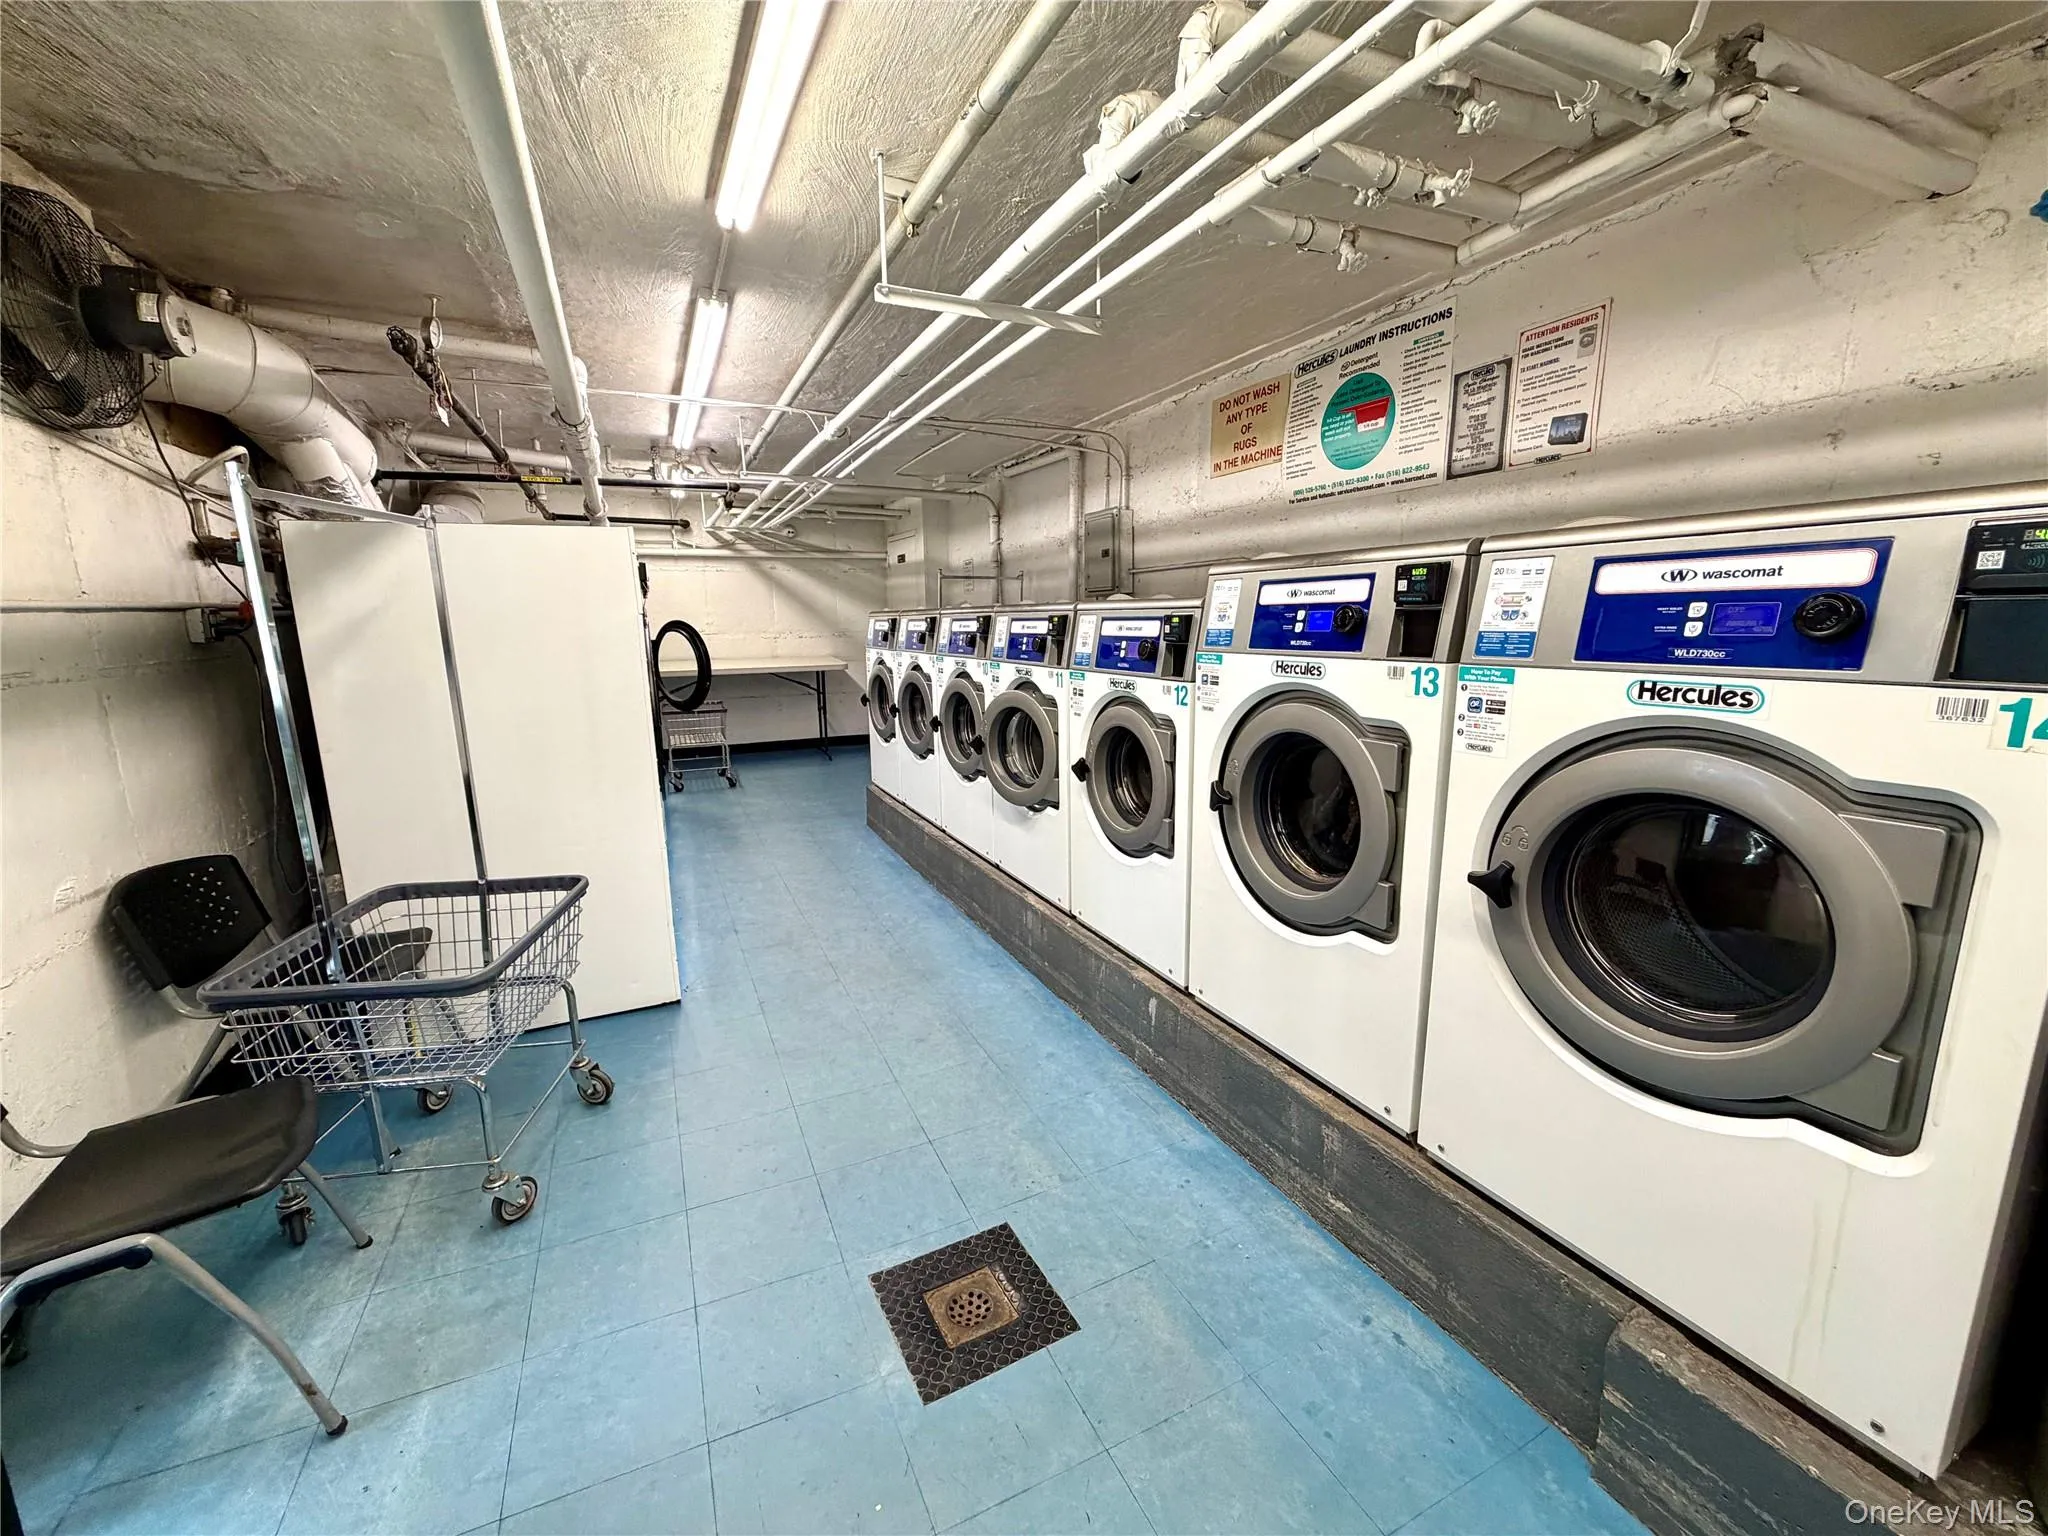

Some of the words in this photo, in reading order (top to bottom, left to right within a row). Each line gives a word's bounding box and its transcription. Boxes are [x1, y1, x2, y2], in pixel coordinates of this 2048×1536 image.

[1525, 325, 1560, 342] ATTENTION
[1561, 312, 1599, 331] RESIDENTS
[1296, 350, 1336, 377] Hercules
[1339, 334, 1377, 358] LAUNDRY
[1379, 308, 1453, 343] INSTRUCTIONS
[1350, 352, 1379, 367] Detergent
[1526, 363, 1539, 372] START
[1338, 360, 1381, 380] Recommended
[1220, 400, 1231, 413] DO
[1233, 392, 1251, 408] NOT
[1253, 381, 1280, 400] WASH
[1226, 410, 1243, 425] ANY
[1245, 402, 1268, 418] TYPE
[1241, 423, 1253, 435] OF
[1234, 437, 1257, 453] RUGS
[1214, 462, 1222, 473] IN
[1224, 457, 1239, 468] THE
[1241, 445, 1283, 466] MACHINE
[1375, 472, 1385, 480] Fax
[1494, 568, 1505, 576] 20
[1702, 565, 1784, 580] wascomat
[1303, 588, 1336, 597] wascomat
[1674, 649, 1726, 658] WLD730cc
[982, 662, 989, 676] 10
[1276, 660, 1322, 677] Hercules
[1056, 672, 1063, 688] 11
[1109, 678, 1136, 690] Hercules
[1411, 666, 1440, 697] 13
[1174, 685, 1188, 707] 12
[1639, 680, 1754, 708] Hercules
[1938, 714, 1985, 723] 367632
